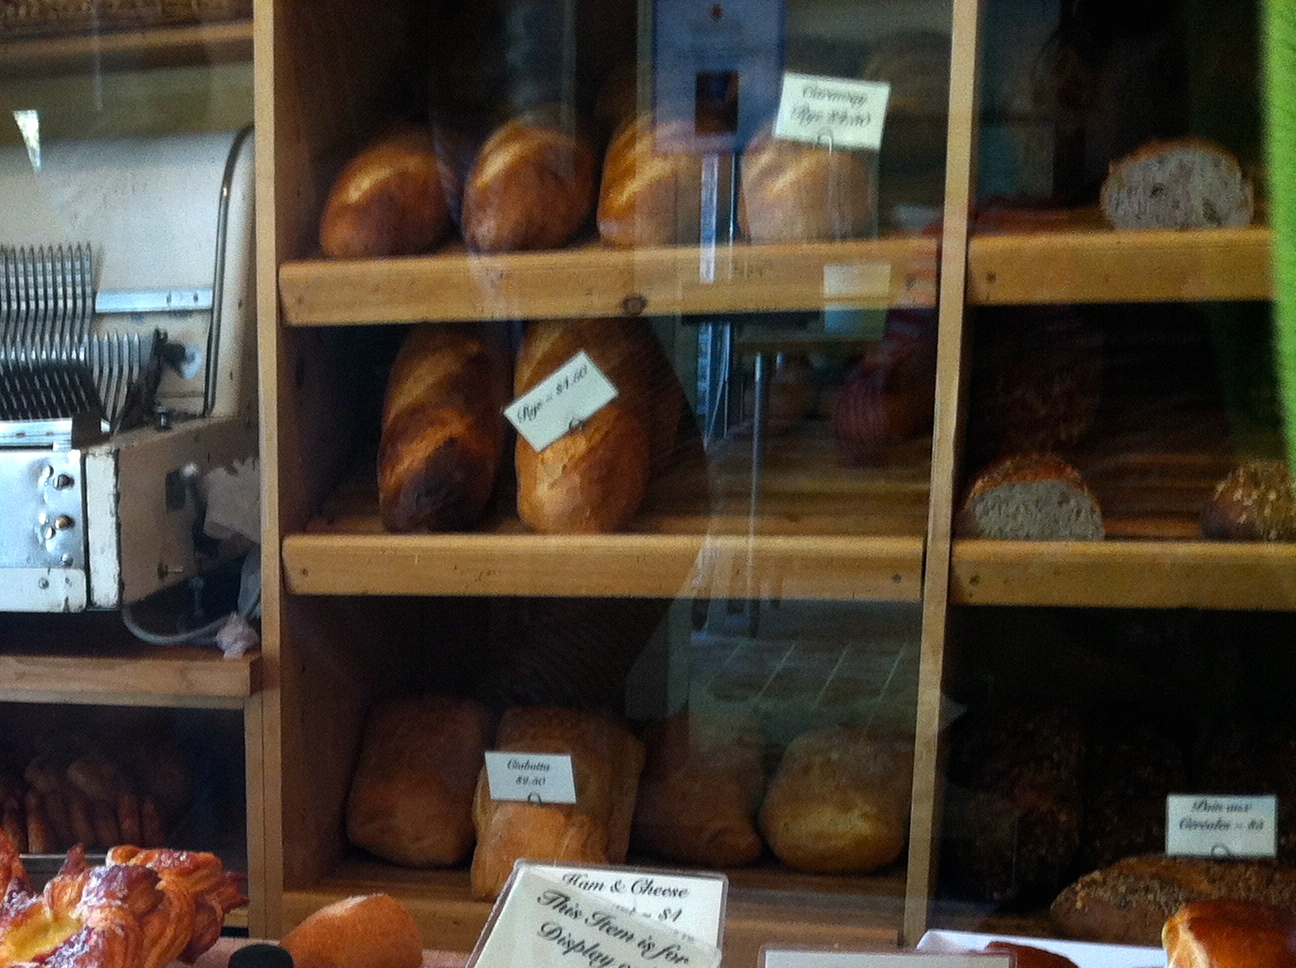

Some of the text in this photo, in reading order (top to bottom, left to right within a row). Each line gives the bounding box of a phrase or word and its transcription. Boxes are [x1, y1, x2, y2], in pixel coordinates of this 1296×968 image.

[561, 872, 689, 899] Ham & Cheese
[537, 889, 583, 919] This
[585, 909, 635, 944] Item
[638, 936, 655, 955] is
[642, 944, 690, 966] for
